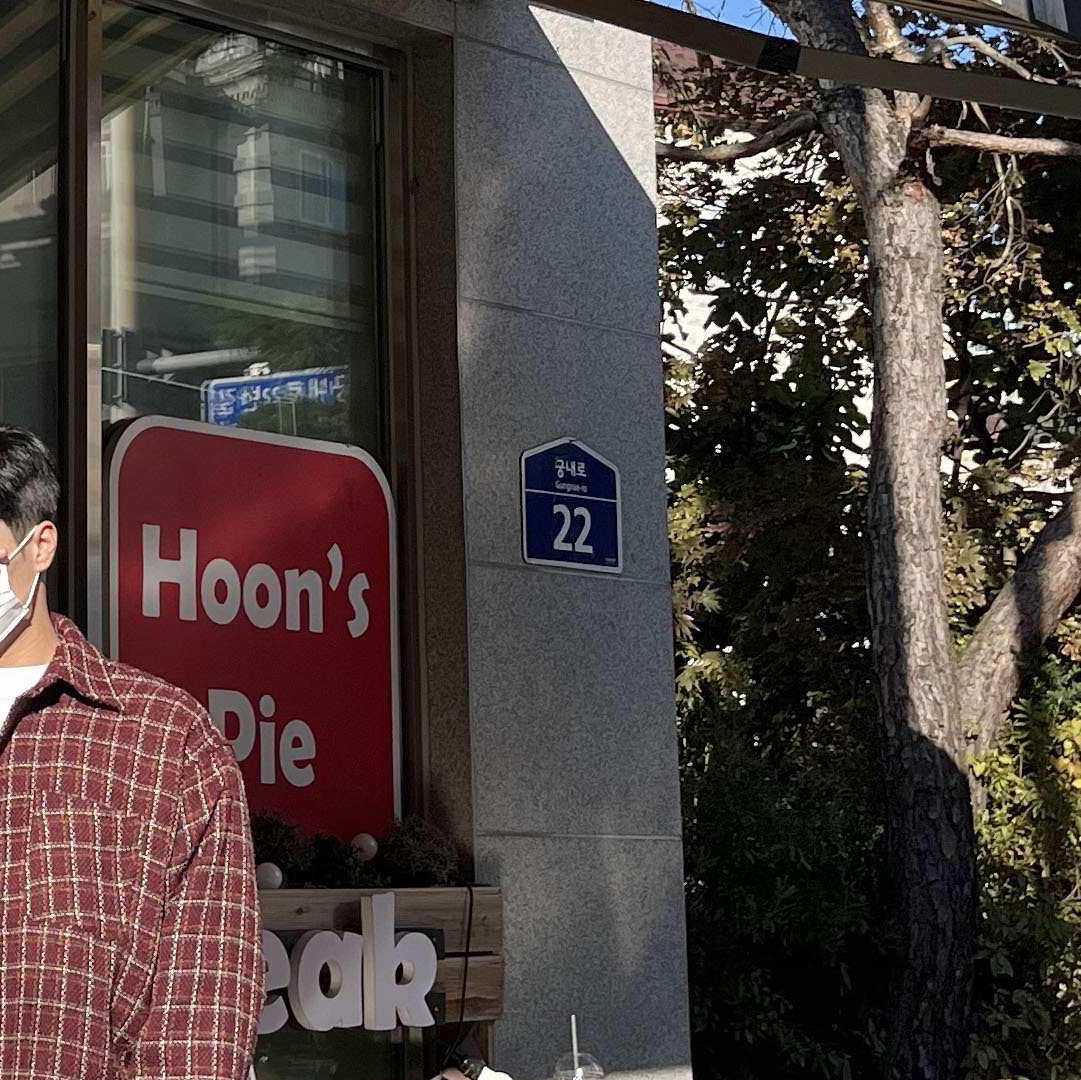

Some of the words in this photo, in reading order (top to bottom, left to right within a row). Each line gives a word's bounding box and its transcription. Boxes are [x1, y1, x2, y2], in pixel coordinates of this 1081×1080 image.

[554, 459, 587, 478] 궁내로
[553, 504, 594, 554] 22
[141, 523, 370, 638] Hoon's
[208, 688, 317, 788] Pie
[257, 891, 436, 1035] eak
